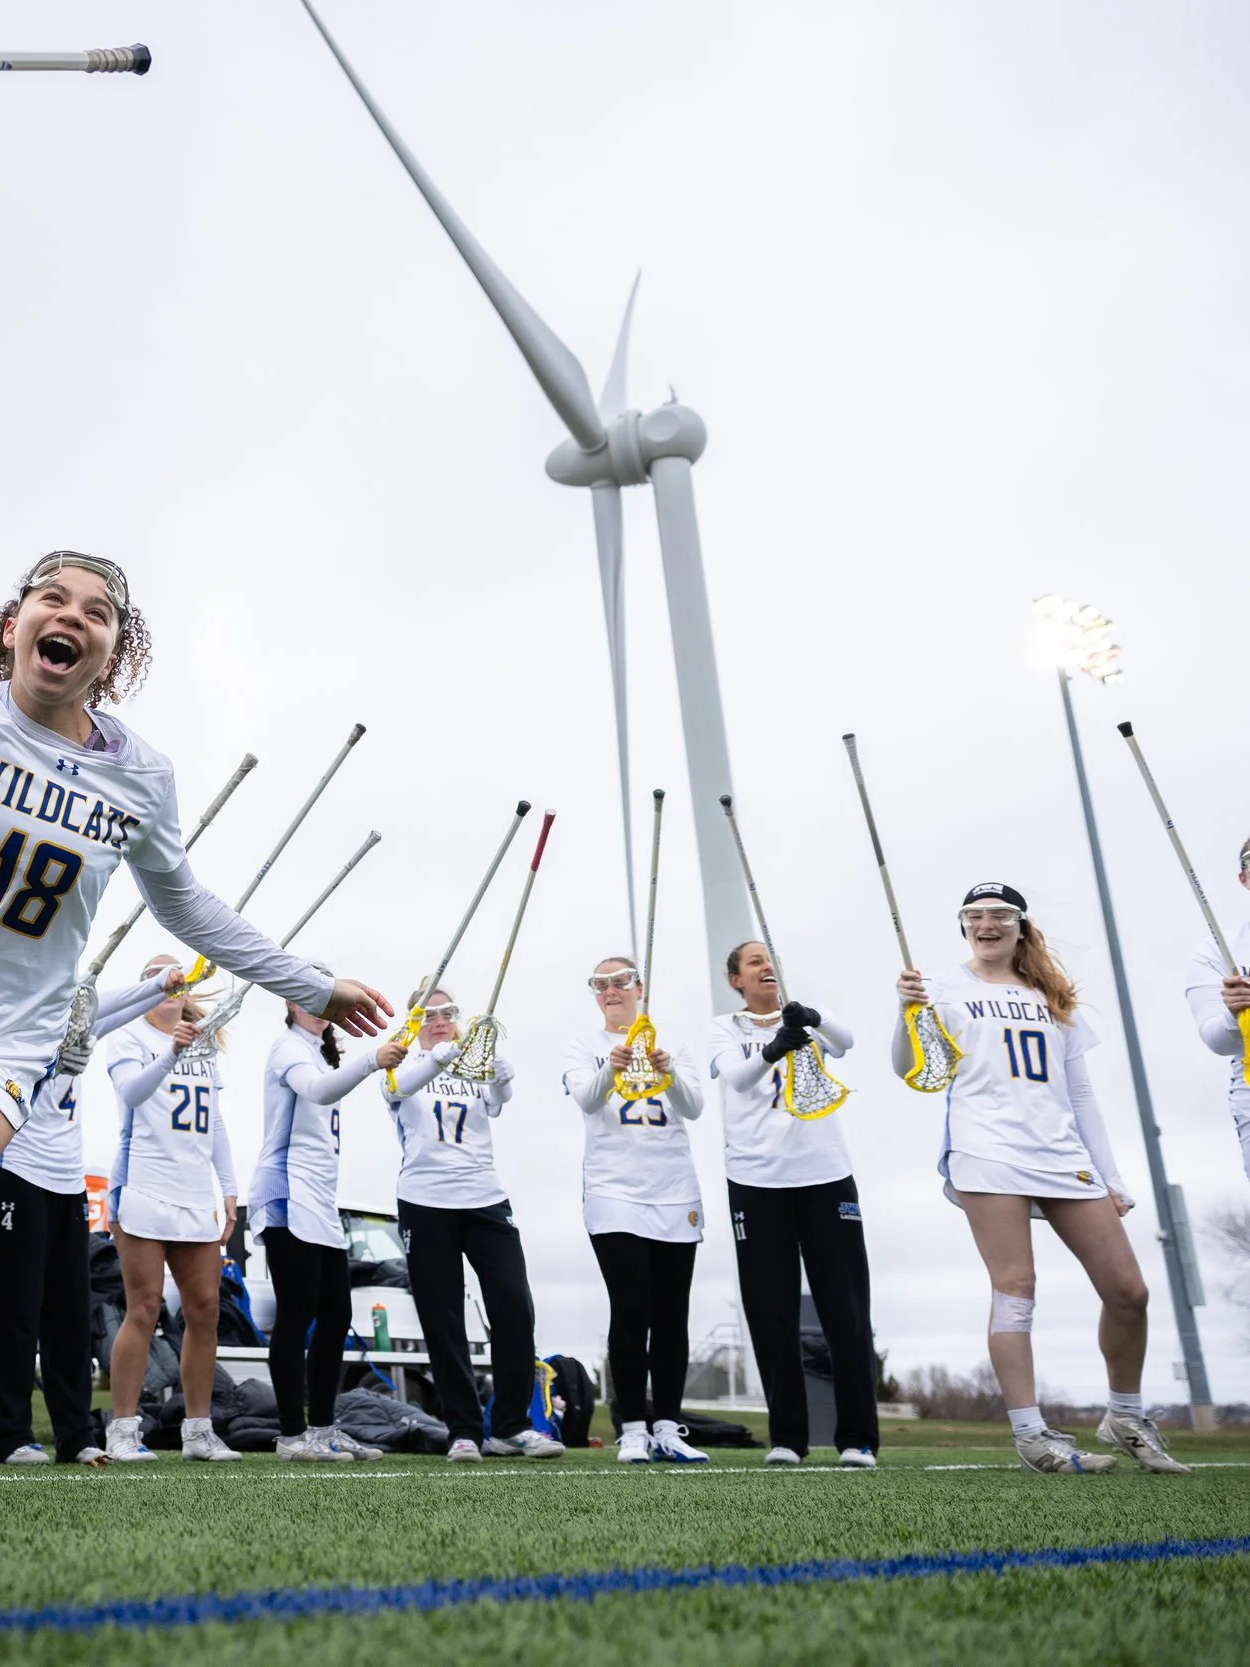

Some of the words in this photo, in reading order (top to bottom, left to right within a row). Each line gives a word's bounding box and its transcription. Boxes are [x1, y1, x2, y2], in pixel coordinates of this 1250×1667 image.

[964, 1000, 1061, 1030] WILDCAT
[1003, 1026, 1049, 1083] 10
[58, 1082, 77, 1122] 4
[169, 1082, 211, 1135] 26
[432, 1099, 468, 1145] 17
[619, 1082, 669, 1126] 25
[1, 1211, 13, 1231] 4
[838, 1201, 861, 1215] JW
[735, 1222, 747, 1241] 11
